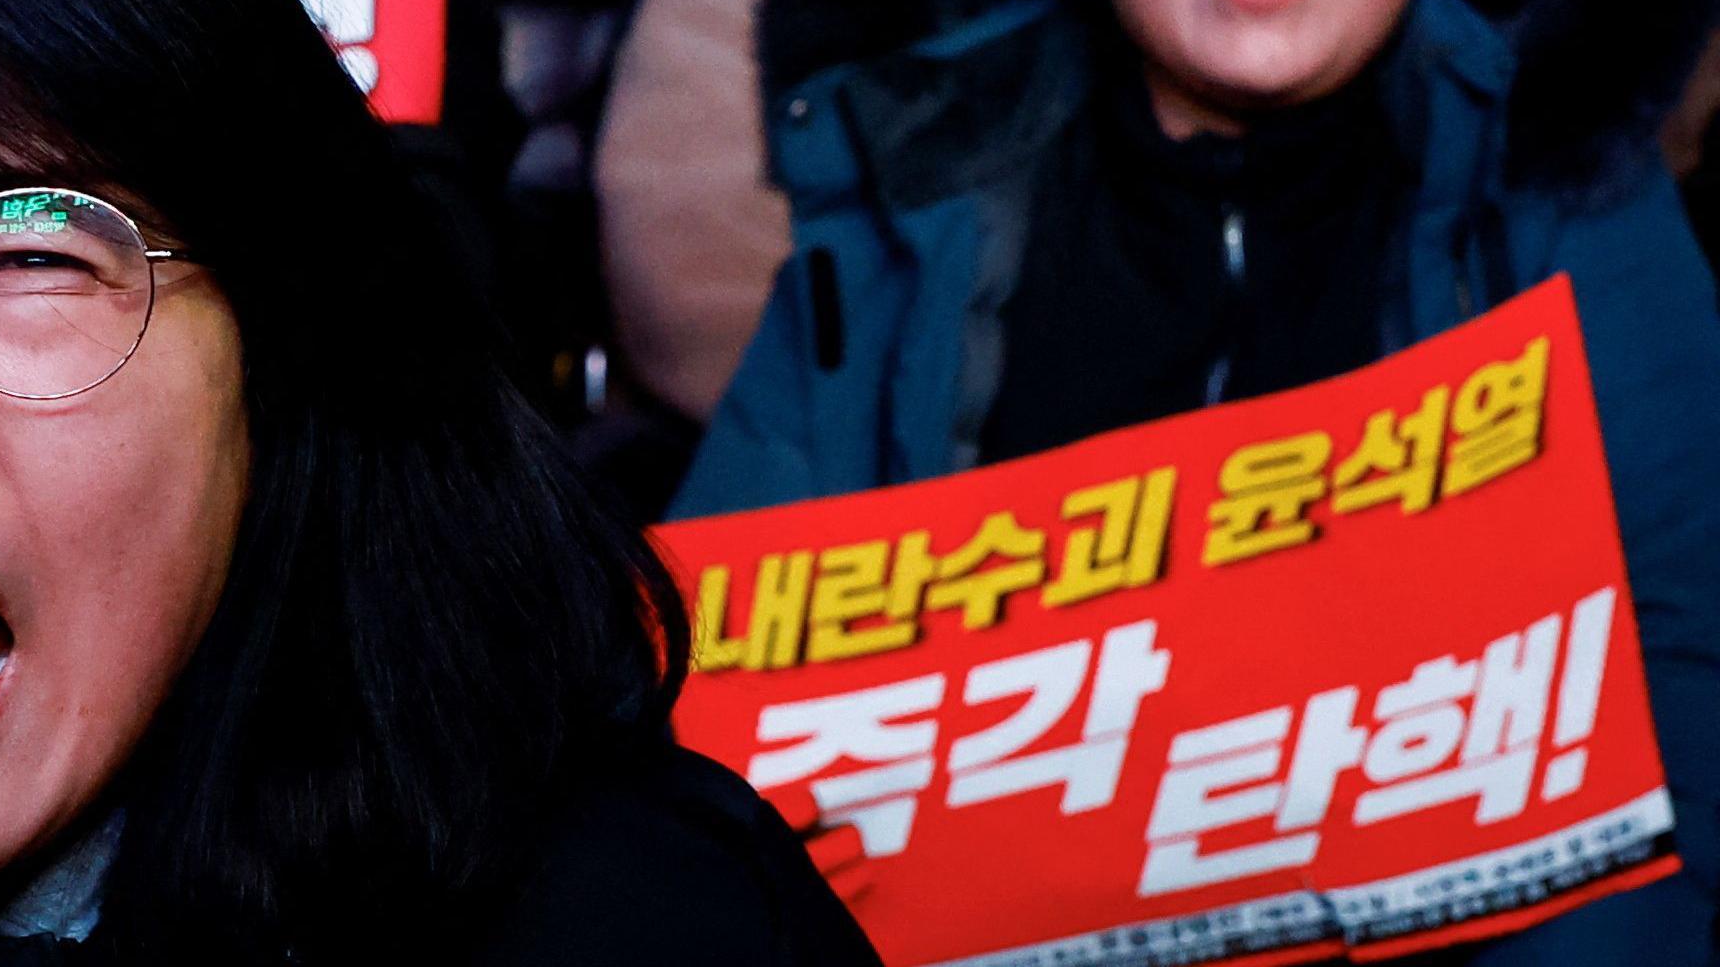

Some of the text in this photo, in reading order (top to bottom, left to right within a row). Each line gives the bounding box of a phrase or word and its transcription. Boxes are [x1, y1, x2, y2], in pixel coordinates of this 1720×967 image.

[690, 337, 1549, 671] 내란수괴 윤석열
[744, 618, 1171, 858] 즉각
[1136, 587, 1617, 898] 탄핵!
